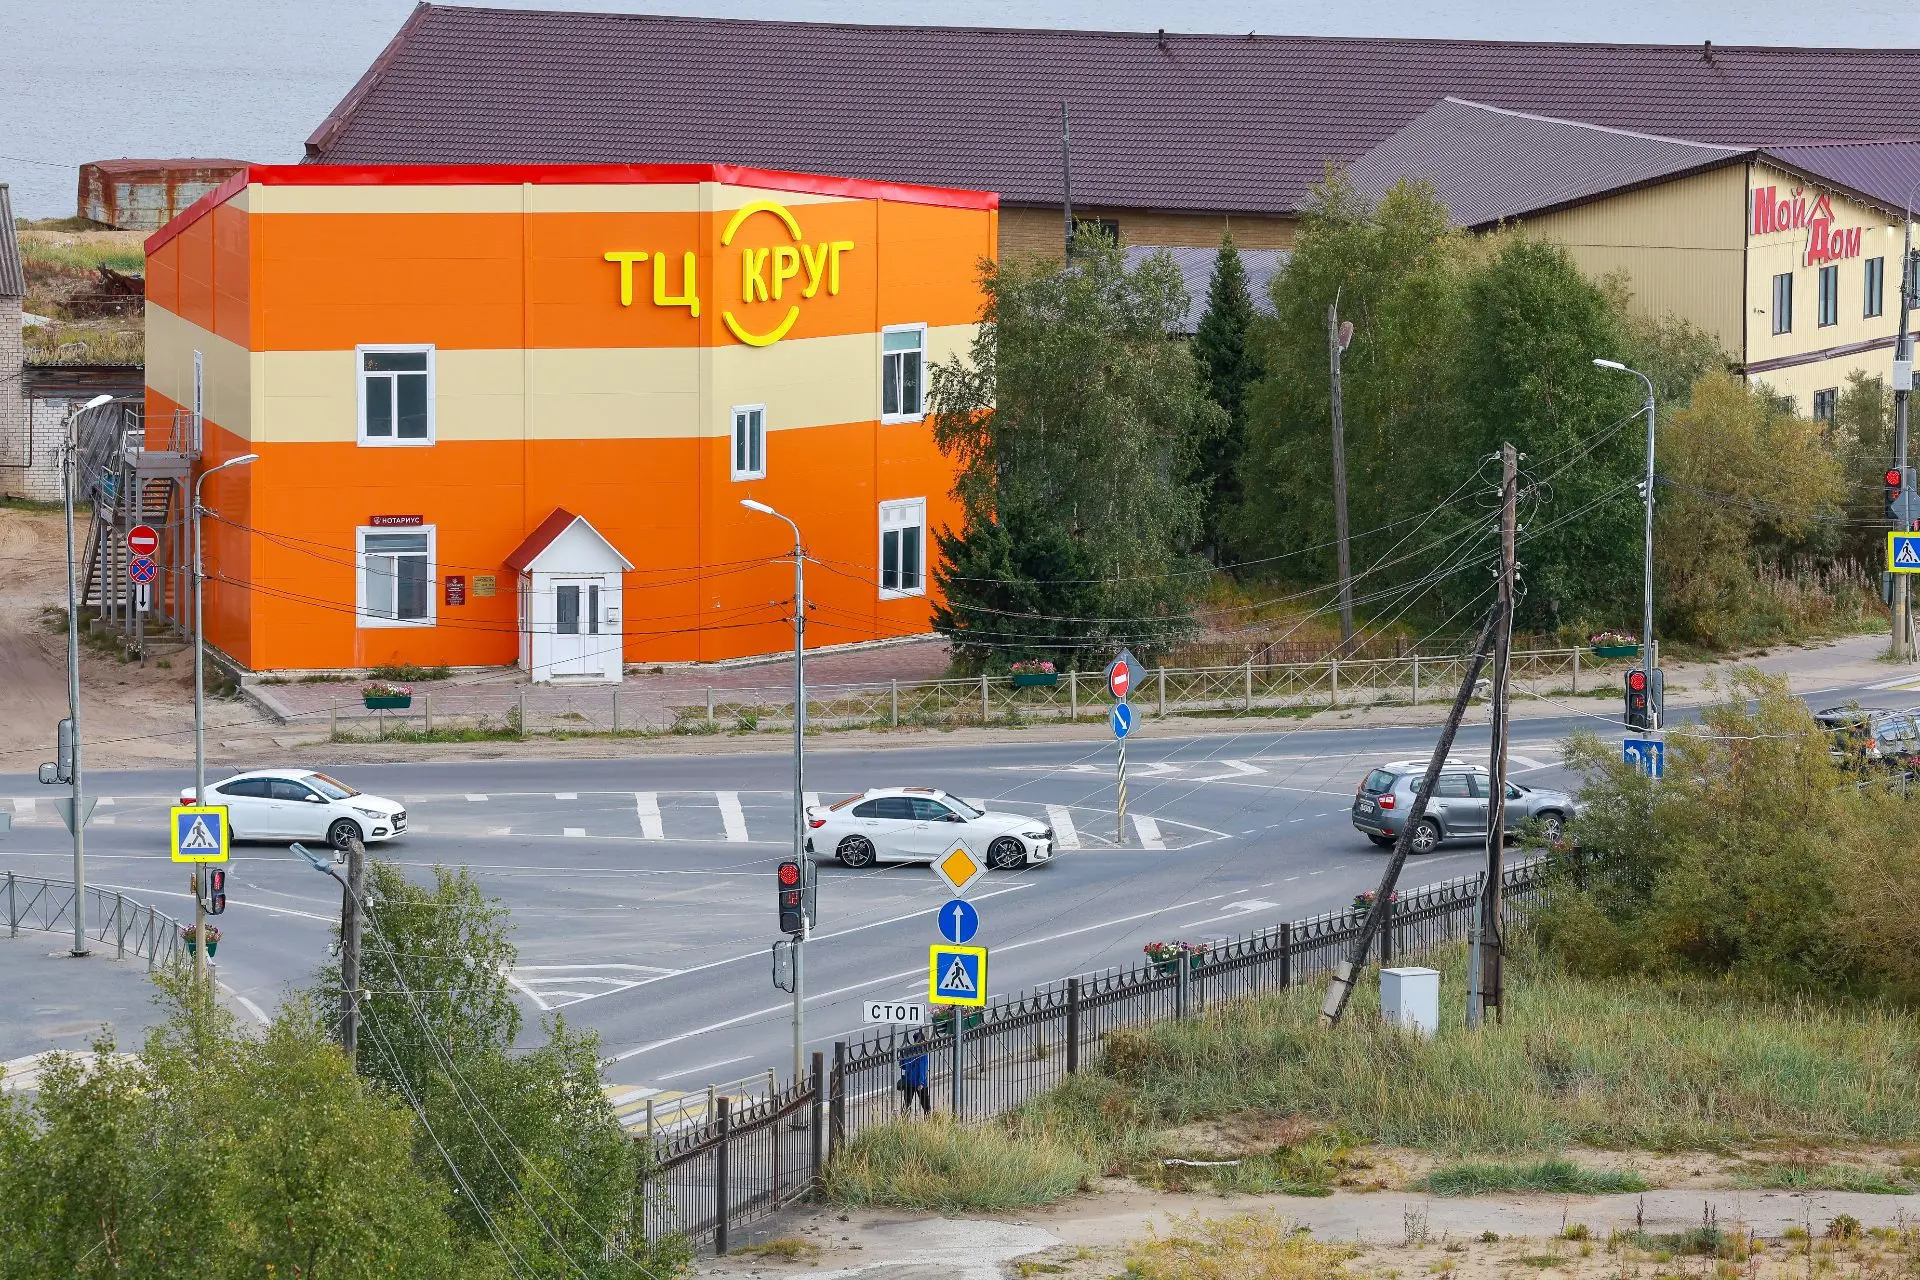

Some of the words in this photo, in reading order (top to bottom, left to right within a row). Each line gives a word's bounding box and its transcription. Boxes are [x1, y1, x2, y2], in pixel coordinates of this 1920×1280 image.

[1751, 186, 1805, 235] Мой
[1804, 215, 1861, 267] Дом
[604, 251, 700, 317] ТЦ
[742, 240, 855, 304] КРУГ
[871, 1004, 919, 1021] СТОП
